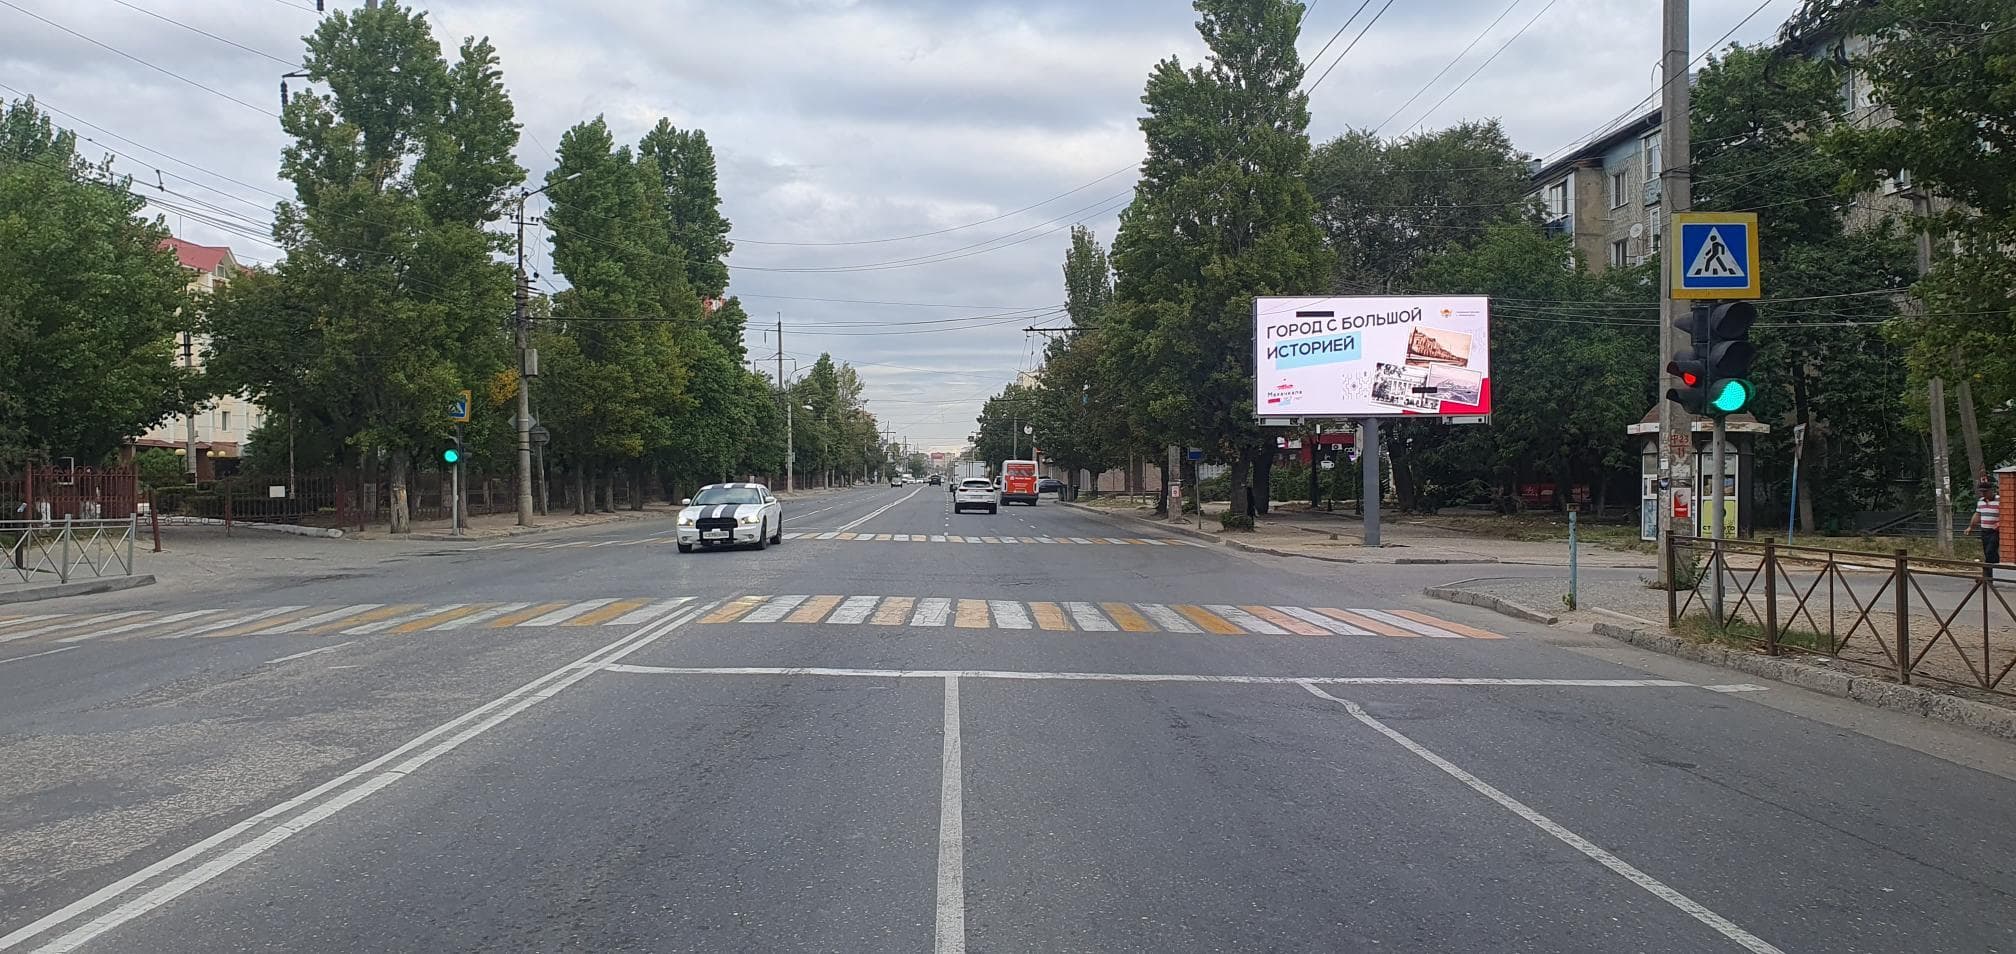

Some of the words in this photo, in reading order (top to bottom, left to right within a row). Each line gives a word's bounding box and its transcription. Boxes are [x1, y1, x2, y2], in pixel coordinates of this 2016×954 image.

[1267, 320, 1322, 339] ГОРОД
[1327, 318, 1338, 331] С
[1342, 307, 1422, 330] БОЛЬШОЙ
[1267, 335, 1355, 359] ИСТОРИЕЙ
